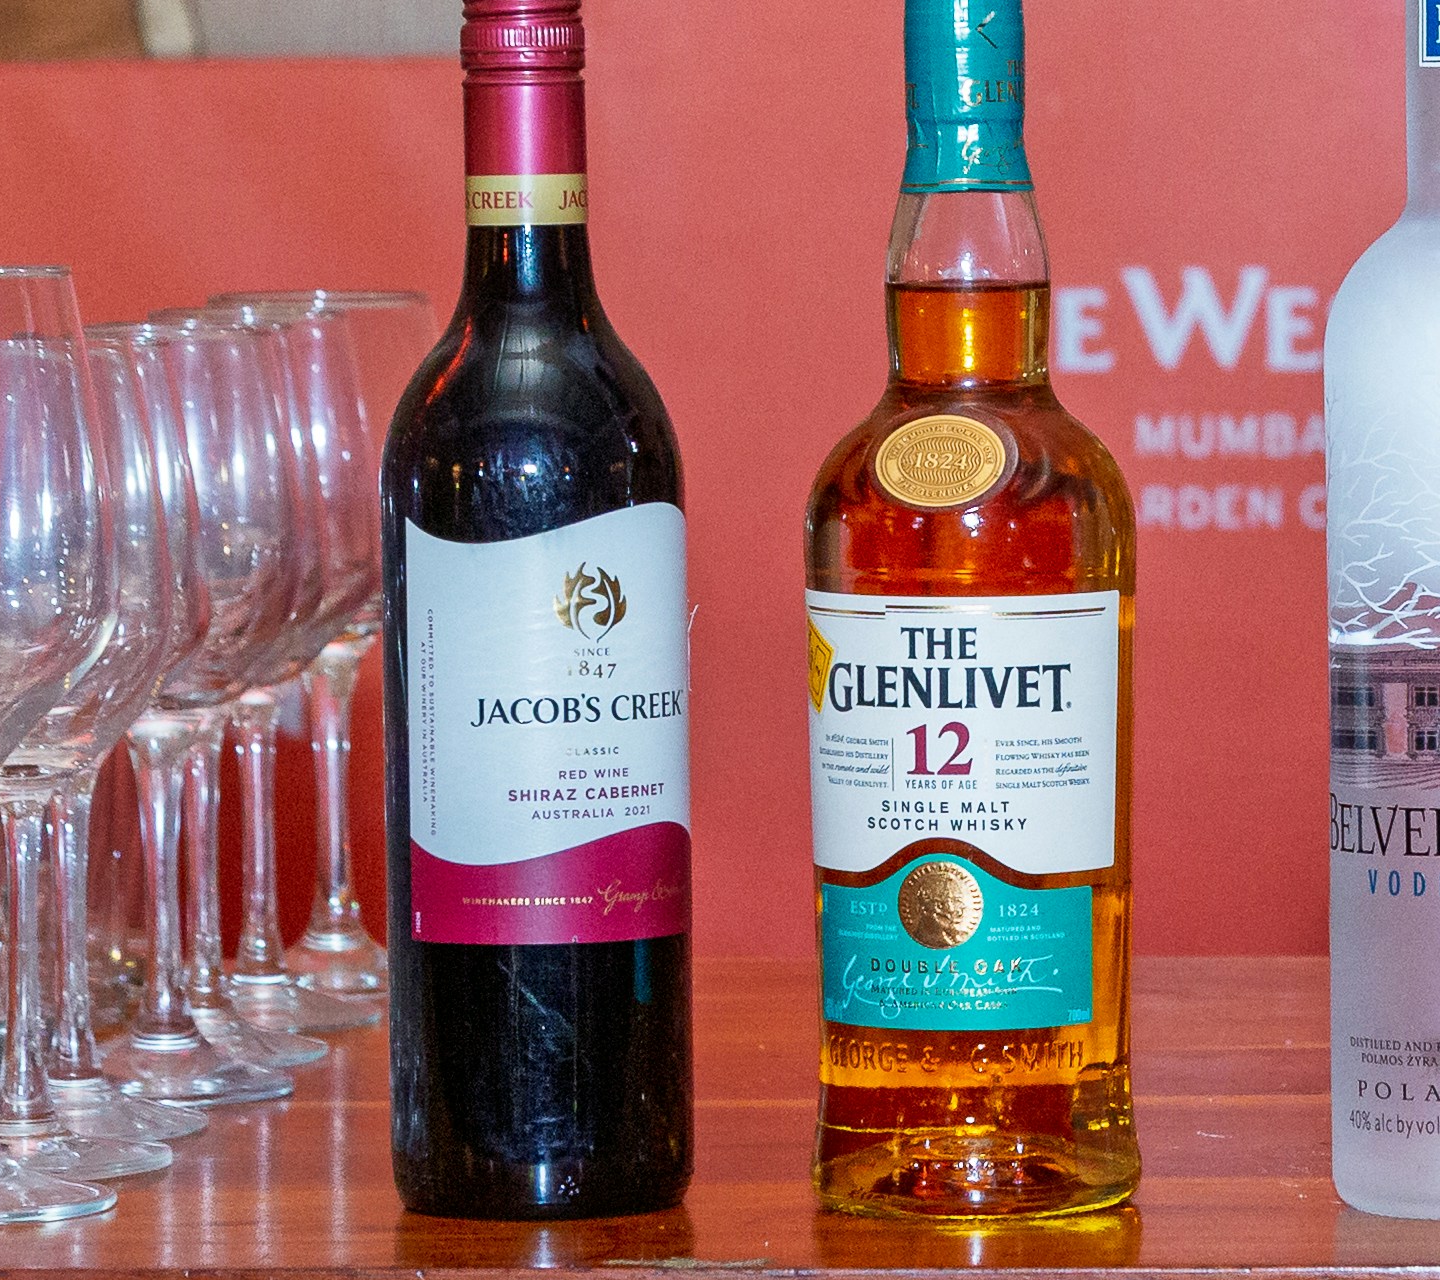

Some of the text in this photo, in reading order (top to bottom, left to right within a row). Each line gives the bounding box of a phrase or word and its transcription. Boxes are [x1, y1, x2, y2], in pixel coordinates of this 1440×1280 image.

[472, 191, 533, 209] CREEK
[915, 452, 969, 469] 1824
[901, 627, 977, 660] THE
[574, 648, 610, 656] SINCE
[567, 660, 617, 678] 1847
[829, 663, 1071, 712] GLENLIVET
[470, 691, 681, 728] JACOB'S CREEK
[565, 746, 620, 756] CLASSIC
[906, 721, 974, 776] 12
[559, 768, 629, 780] RED WINE
[905, 778, 978, 790] YEARS OF AGE
[508, 783, 665, 802] SHIRAZ CABERNET
[532, 805, 650, 820] AUSTRALIA 2021
[881, 800, 1010, 814] SINGLE MALT
[867, 817, 1028, 832] SCOTCH WHISKY
[534, 896, 566, 906] SINCE
[1000, 903, 1039, 918] 1824
[990, 925, 1025, 933] MATURED
[987, 934, 1019, 942] BOTTLED
[871, 957, 1022, 975] DOUBLE OAK
[1350, 1036, 1401, 1051] DISTILLED
[1404, 1041, 1433, 1052] AND
[1001, 1040, 1084, 1073] SMITH
[1361, 1053, 1403, 1066] POLMOS
[1349, 1110, 1371, 1131] 40%
[1374, 1113, 1393, 1133] alc
[1396, 1114, 1413, 1139] by
[1416, 1116, 1440, 1135] vol
